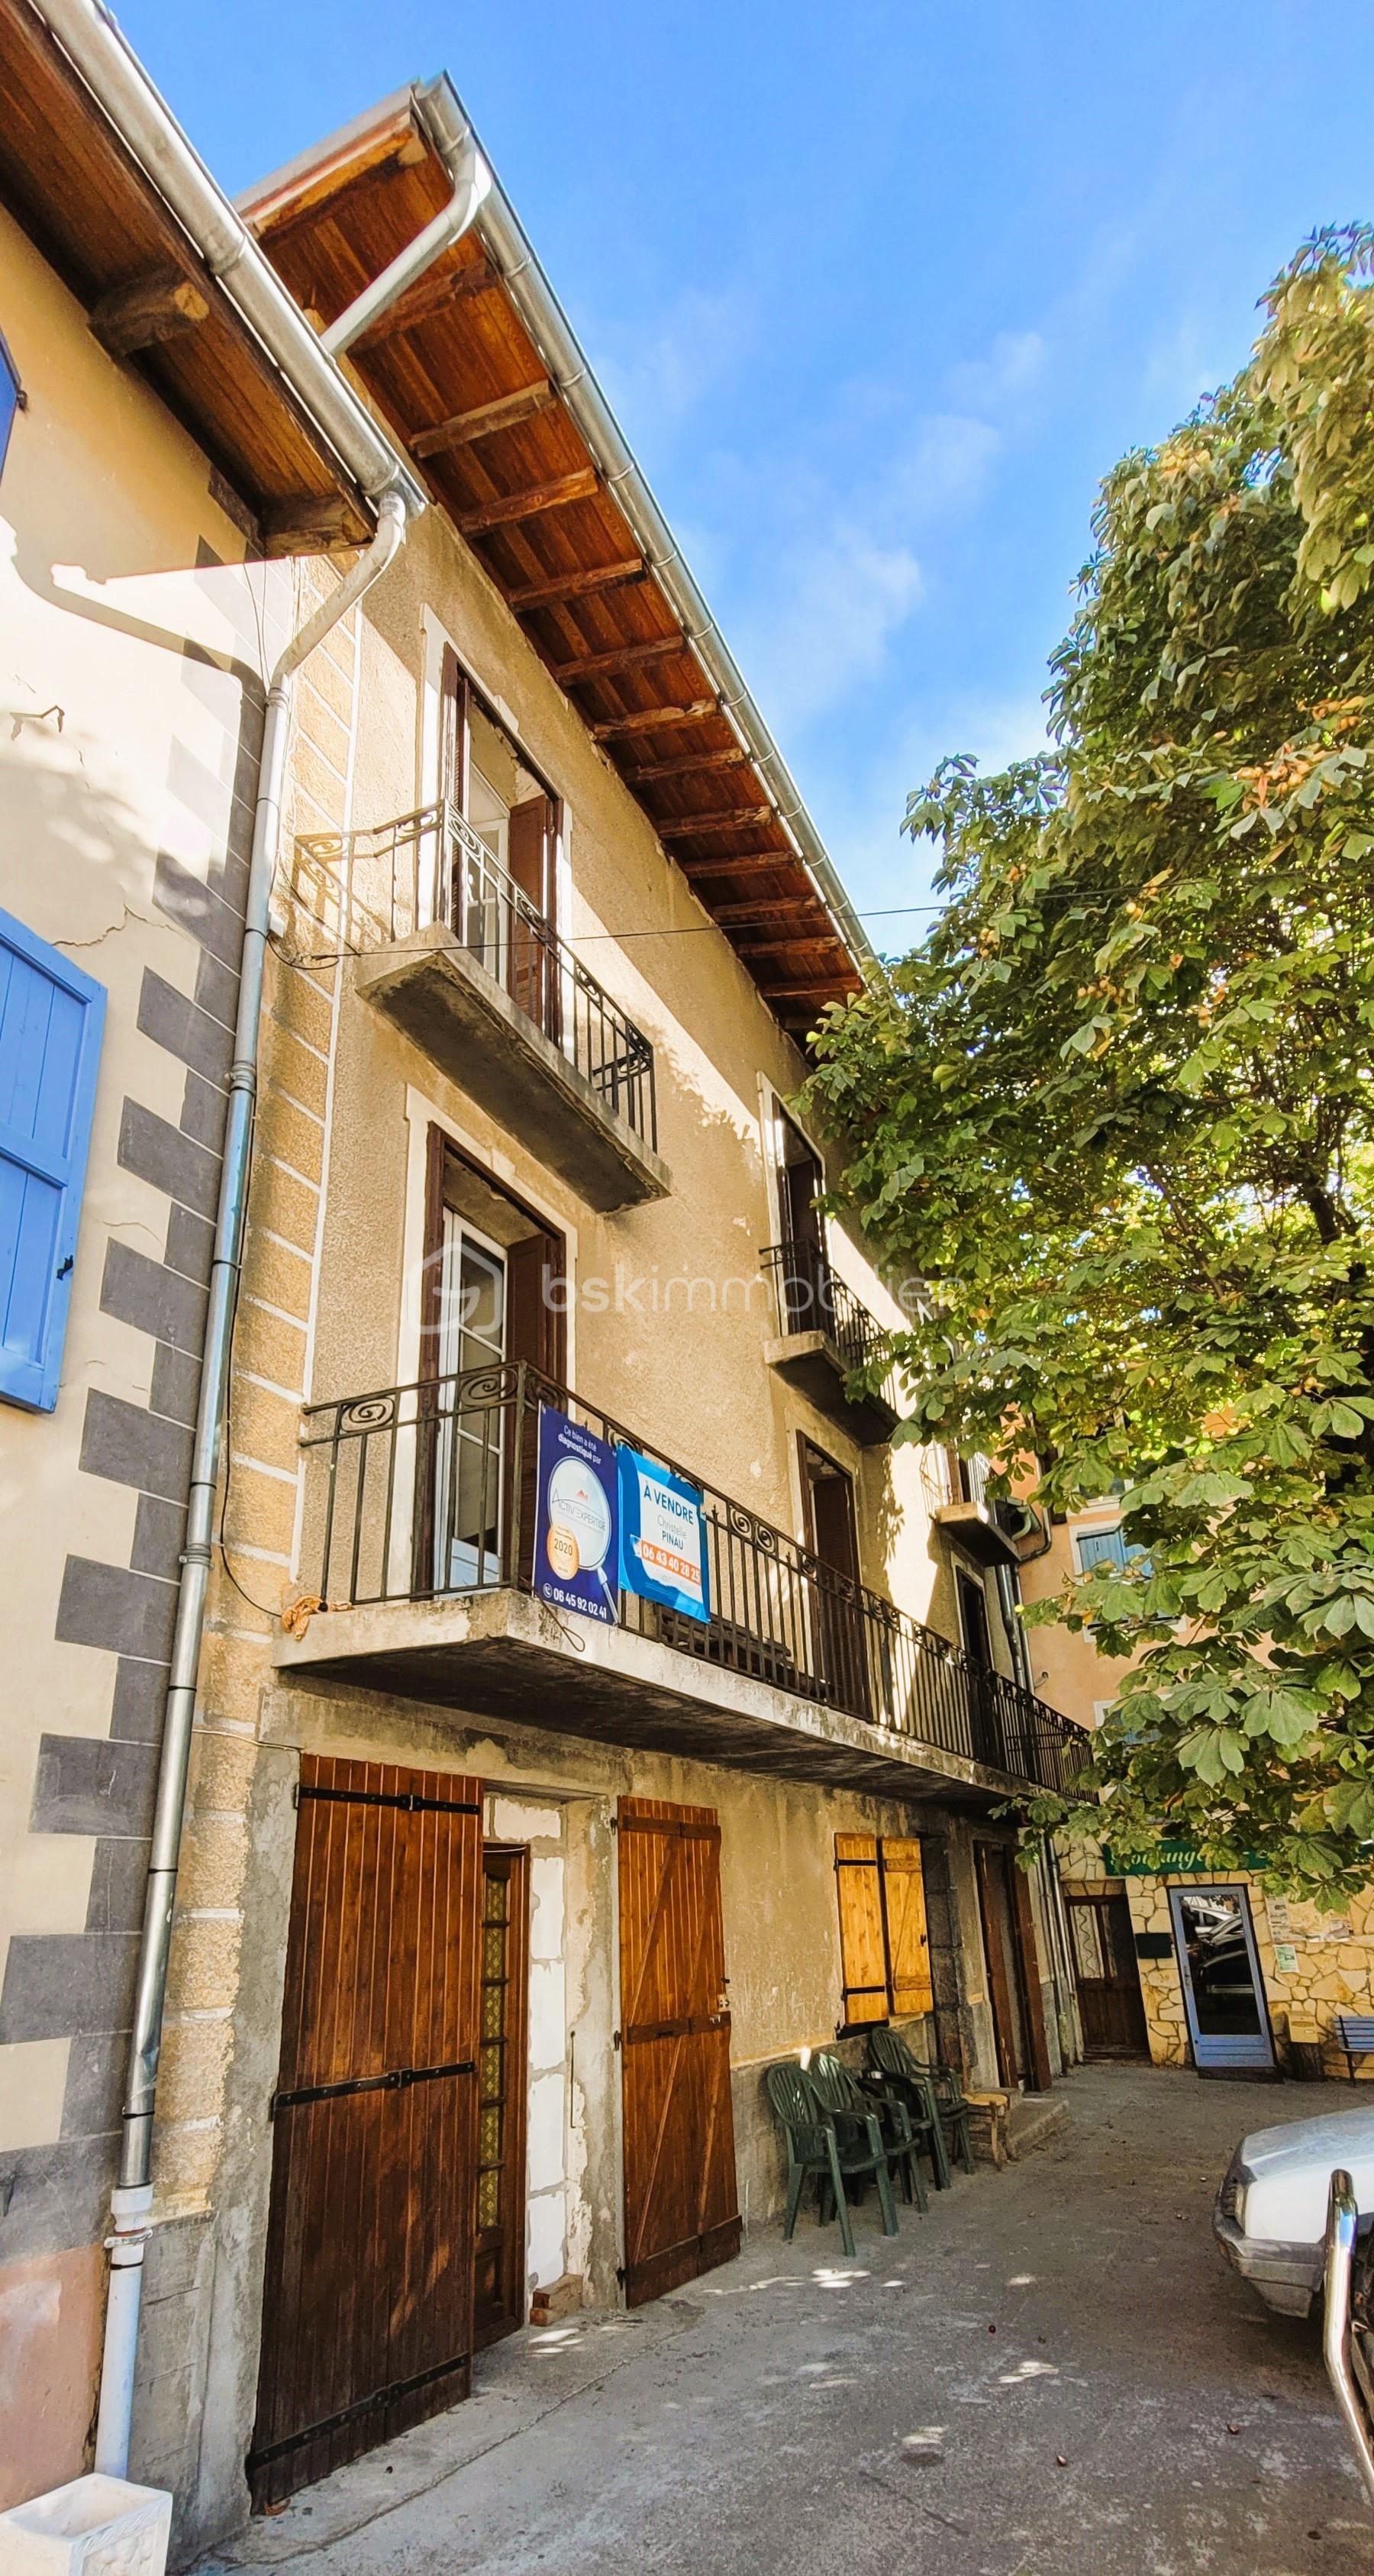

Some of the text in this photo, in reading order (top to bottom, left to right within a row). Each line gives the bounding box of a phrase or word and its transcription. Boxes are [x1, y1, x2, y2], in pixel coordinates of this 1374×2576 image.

[653, 1489, 694, 1525] VENDRE
[554, 1538, 573, 1556] 2020
[662, 1530, 684, 1551] PINAU
[643, 1544, 655, 1561] 06
[656, 1550, 668, 1567] 43
[668, 1556, 679, 1572] 40
[690, 1567, 701, 1583] 25
[553, 1587, 607, 1619] 06 45 92 02 41
